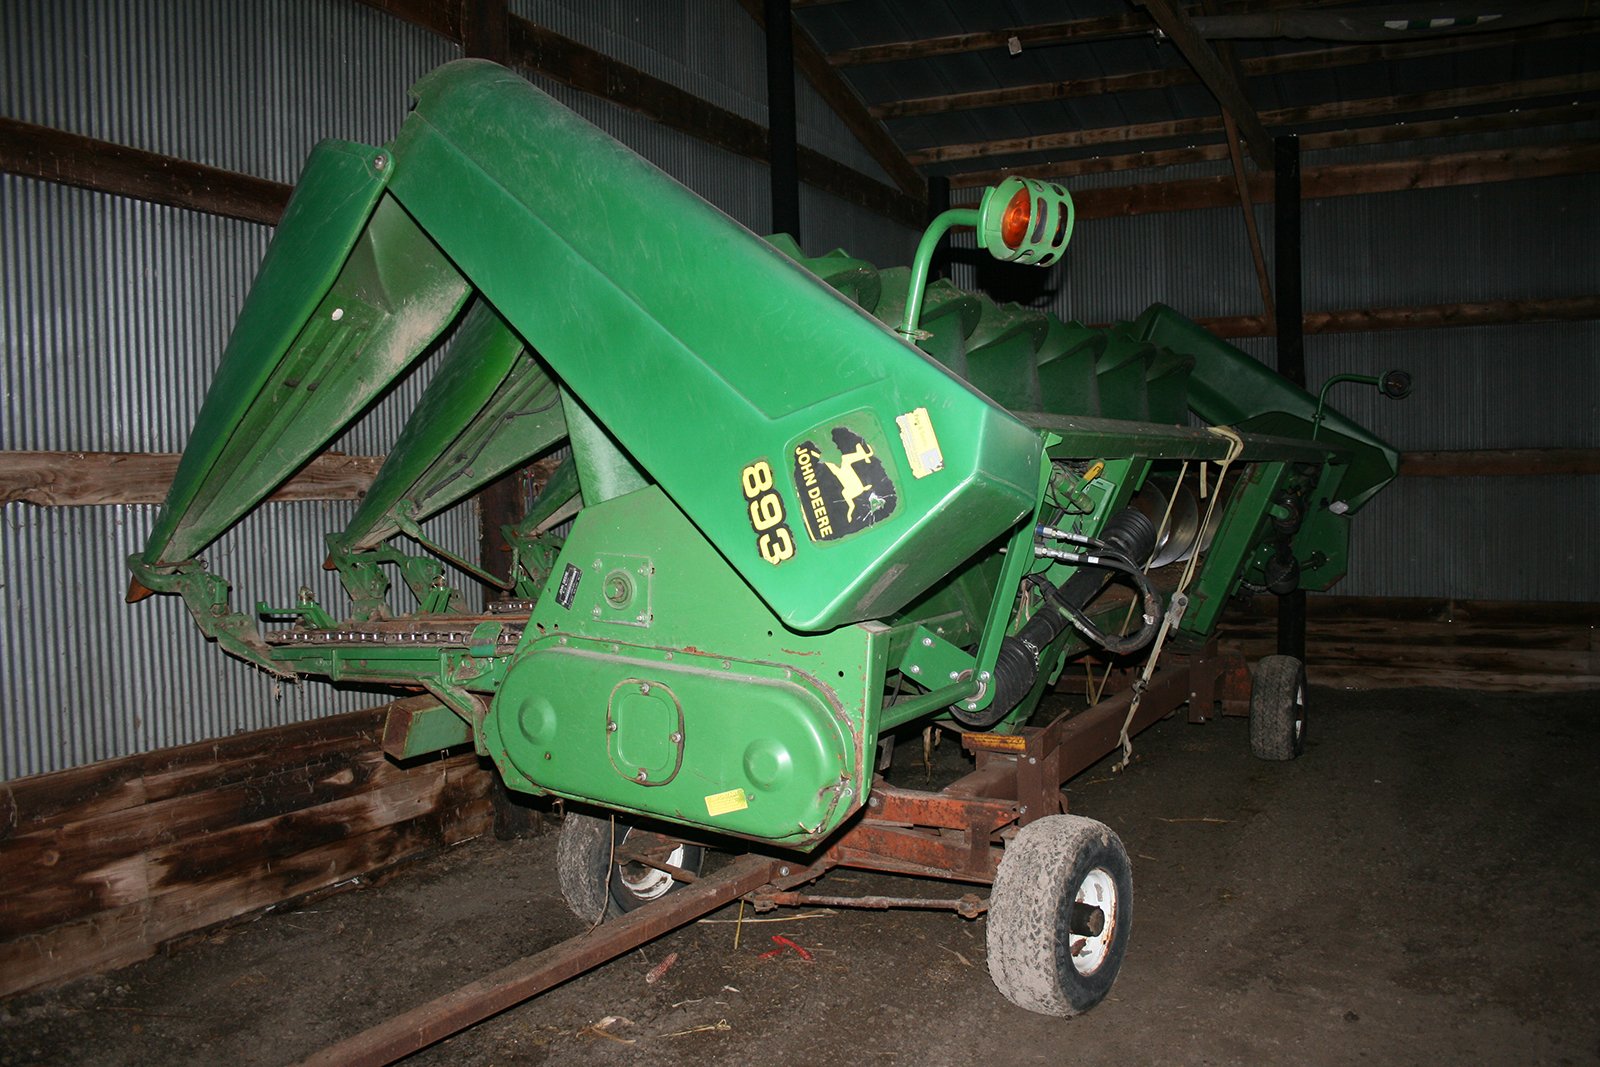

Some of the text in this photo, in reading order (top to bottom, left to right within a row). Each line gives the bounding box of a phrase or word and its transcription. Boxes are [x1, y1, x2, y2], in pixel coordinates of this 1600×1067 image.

[742, 461, 794, 565] 893
[795, 446, 833, 538] JOHN DEERE
